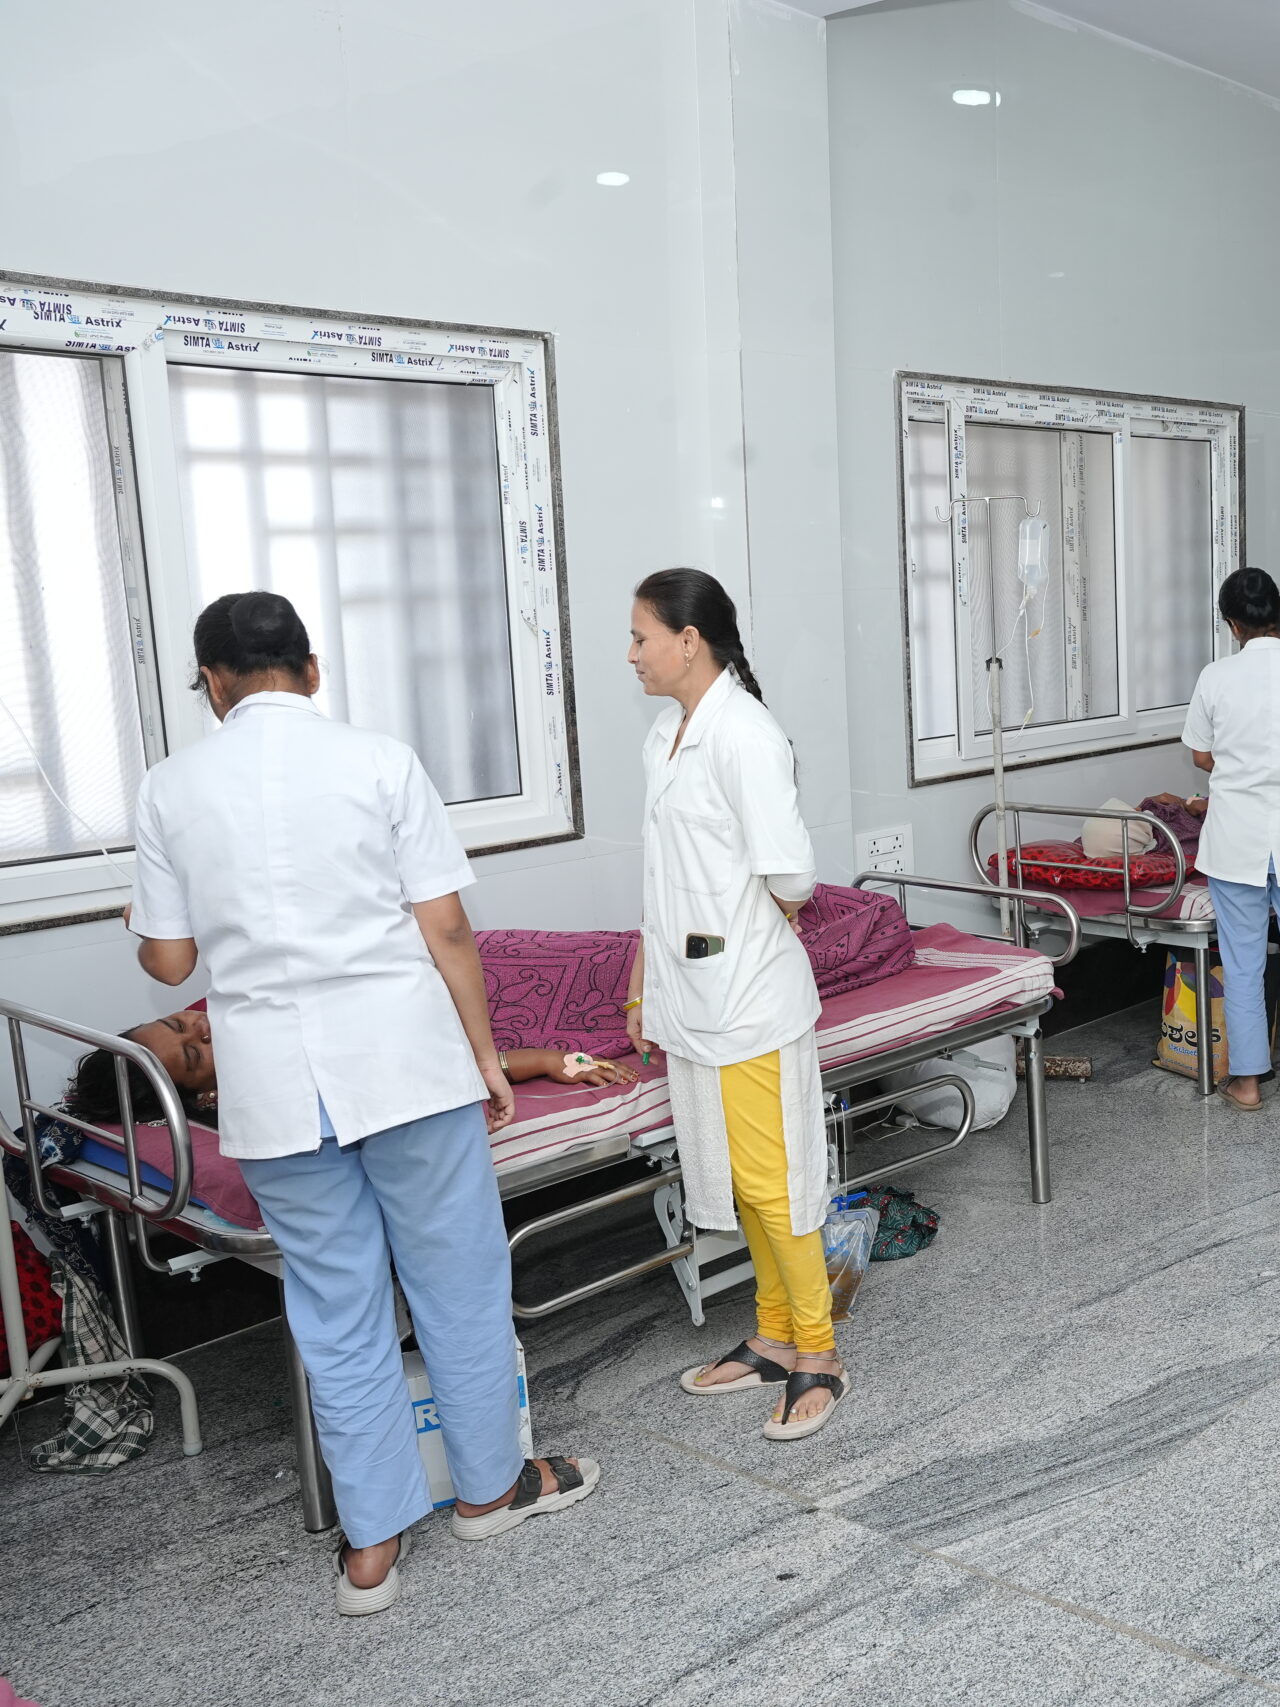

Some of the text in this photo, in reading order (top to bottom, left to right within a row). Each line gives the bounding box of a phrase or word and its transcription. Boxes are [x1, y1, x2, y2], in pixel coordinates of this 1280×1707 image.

[40, 300, 72, 314] SIMTA
[85, 316, 122, 328] Astrix
[164, 315, 245, 333] SIMTA Astrix
[184, 335, 260, 352] SIMTA Astrix
[311, 330, 382, 346] SIMTA Astrix
[371, 352, 434, 366] SIMTA Astrix
[448, 344, 510, 358] SIMTA Astrix
[527, 367, 538, 436] SIMTA Astrix
[519, 520, 528, 543] SIMTA
[535, 504, 546, 572] SIMTA Astrix
[542, 629, 554, 696] SIMTA Astrix
